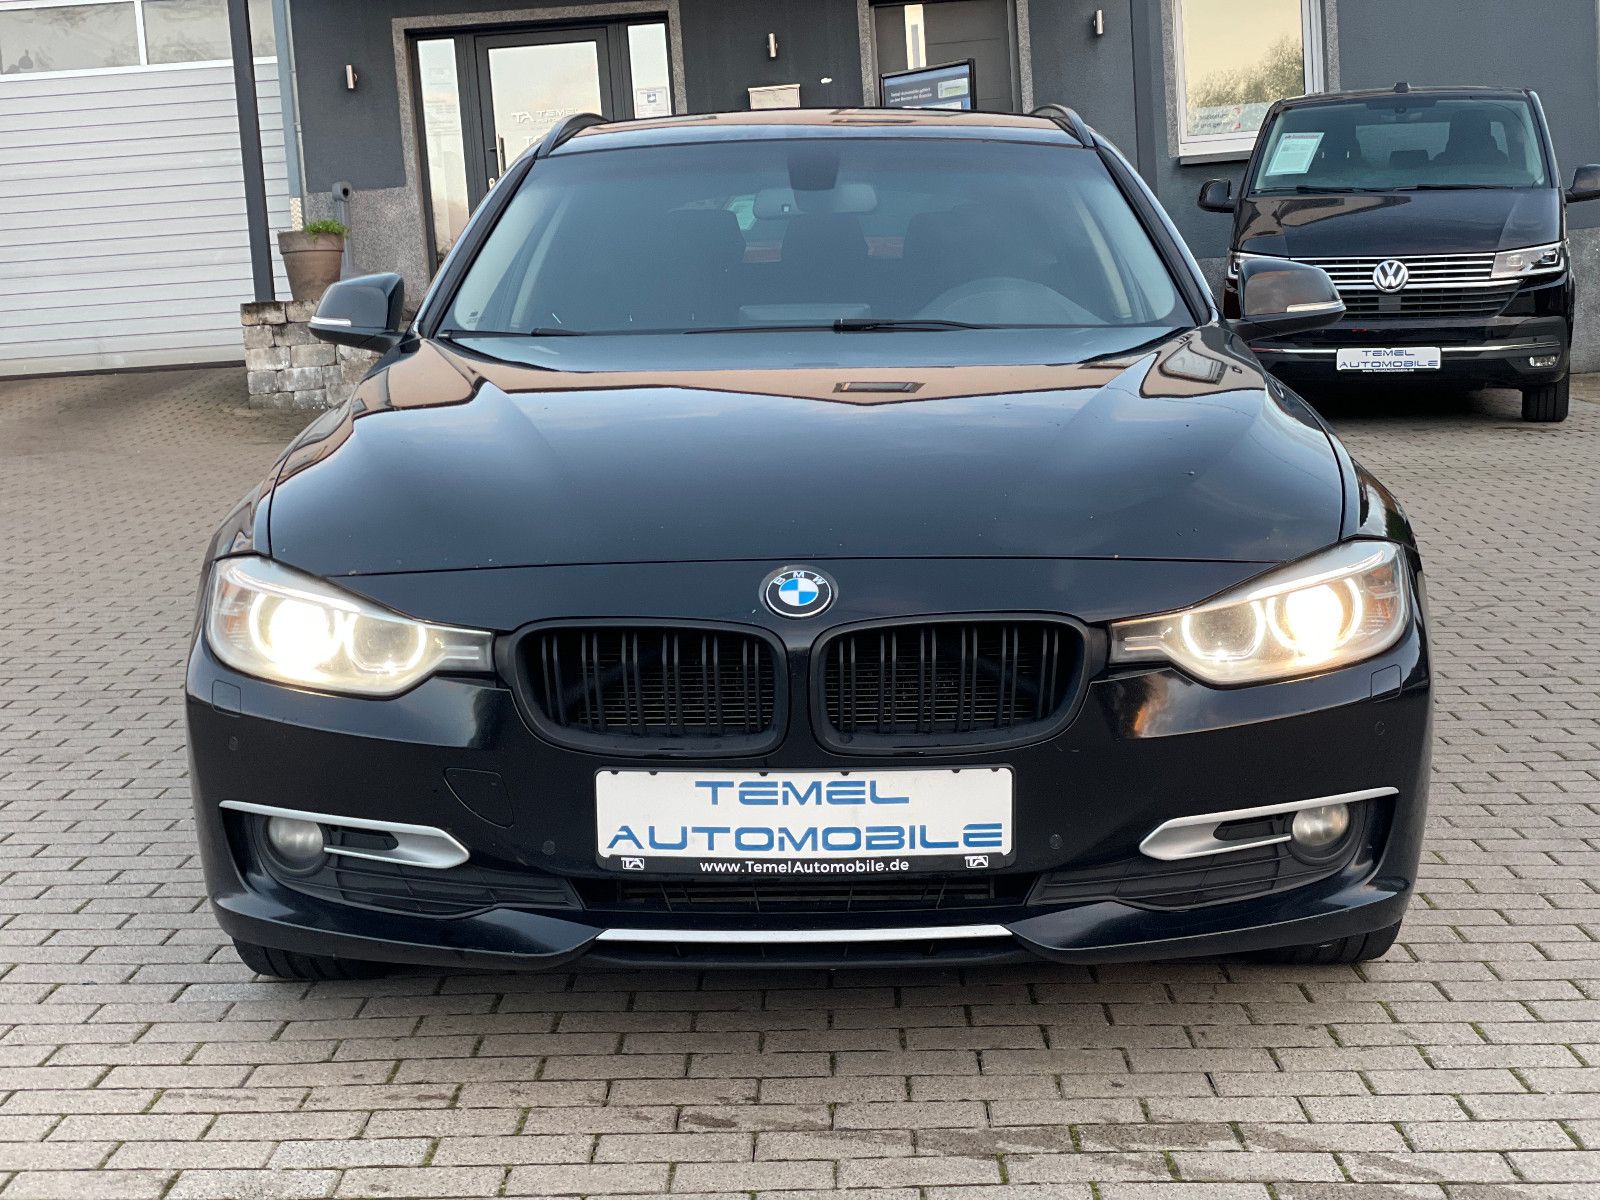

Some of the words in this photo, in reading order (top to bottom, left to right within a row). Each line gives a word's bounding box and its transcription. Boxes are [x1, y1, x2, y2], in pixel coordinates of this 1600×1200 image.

[1362, 349, 1415, 357] TEMEL
[1339, 360, 1438, 369] AUTOMOBILE
[773, 570, 826, 586] BMW
[695, 780, 910, 806] TEMEL
[607, 822, 1003, 852] AUTOMOBILE
[699, 859, 910, 874] www.TemelAutomobile.de
